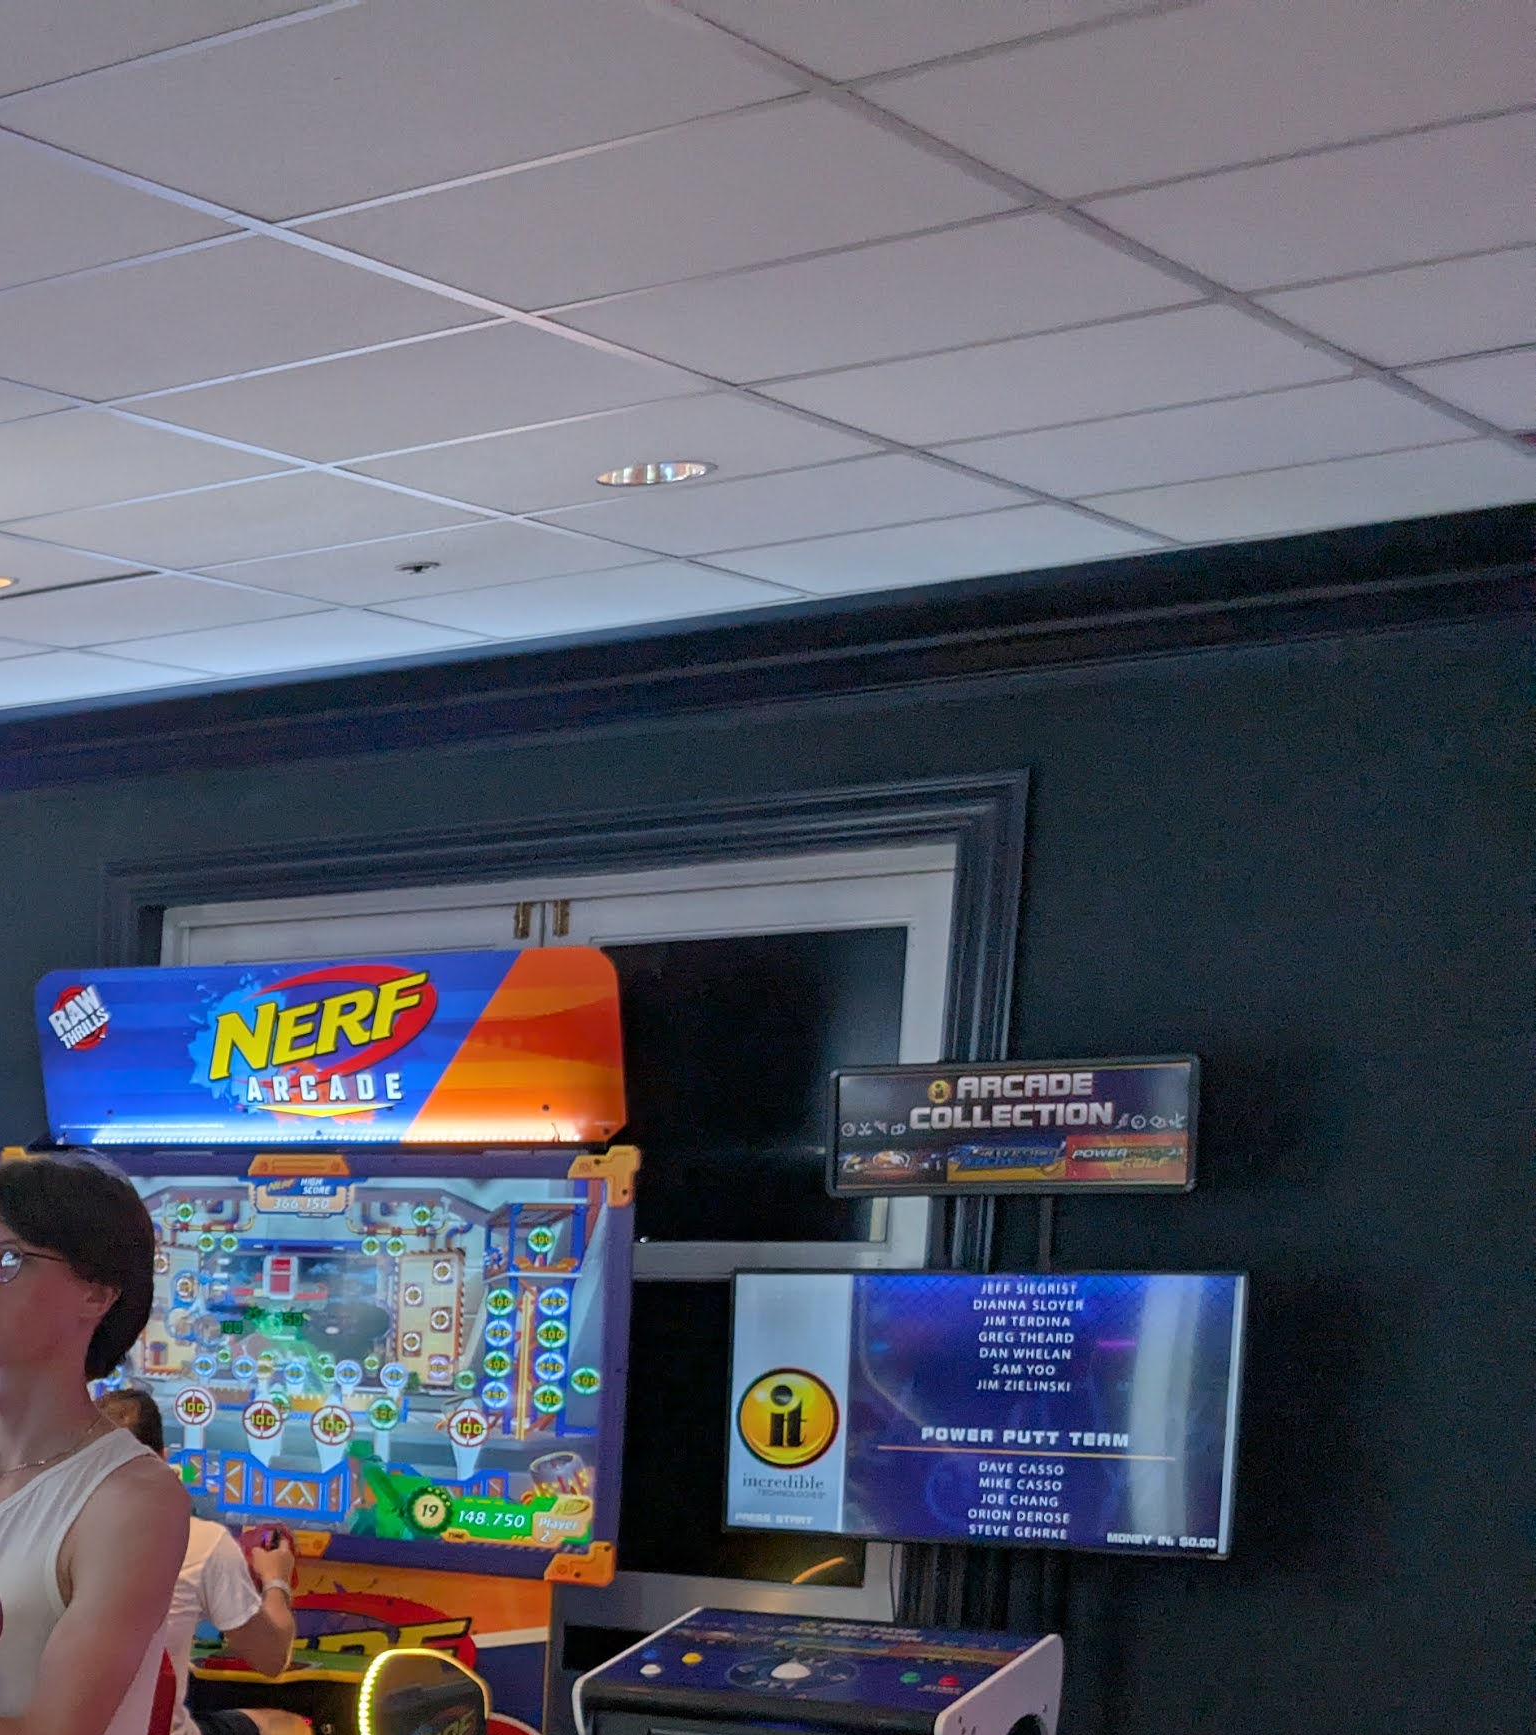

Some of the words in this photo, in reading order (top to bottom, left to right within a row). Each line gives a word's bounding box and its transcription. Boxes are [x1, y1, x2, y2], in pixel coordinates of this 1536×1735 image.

[48, 985, 100, 1037] RAW
[60, 1007, 110, 1049] THRILLS
[209, 972, 428, 1080] NERF
[247, 1073, 402, 1102] ARCADE
[956, 1073, 1093, 1100] ARCADE
[910, 1102, 1113, 1129] COLLECTION
[980, 1283, 1011, 1295] JEFF
[1016, 1283, 1078, 1296] SIEGRIST
[972, 1300, 1026, 1311] DIANNA
[1032, 1300, 1084, 1311] SLOYER
[983, 1316, 1006, 1327] JIM
[1011, 1316, 1071, 1328] TERDINA
[978, 1332, 1014, 1343] GREG
[1019, 1332, 1075, 1344] THEARD
[979, 1348, 1008, 1359] DAN
[1013, 1348, 1072, 1360] WHELAN
[992, 1364, 1022, 1375] SAM
[1026, 1364, 1056, 1376] YOO
[976, 1379, 999, 1390] JIM
[1003, 1380, 1071, 1393] ZIELINSKI
[765, 1385, 807, 1447] it
[456, 1423, 483, 1435] 100
[921, 1427, 994, 1442] POWER
[1003, 1429, 1059, 1445] PUTT
[1069, 1431, 1129, 1447] TEAM
[978, 1461, 1014, 1473] DAVE
[1018, 1463, 1065, 1476] CASSO
[742, 1472, 824, 1490] incredible
[979, 1477, 1012, 1489] MIKE
[1017, 1479, 1063, 1492] CASSO
[980, 1494, 1005, 1505] JOE
[1010, 1495, 1058, 1508] CHANG
[421, 1504, 439, 1518] 19
[539, 1516, 578, 1530] Player
[968, 1508, 1011, 1521] ORION
[1016, 1510, 1070, 1524] DEROSE
[968, 1524, 1009, 1537] STEVE
[1013, 1525, 1068, 1541] GEHRKE
[1107, 1532, 1152, 1545] MONEY
